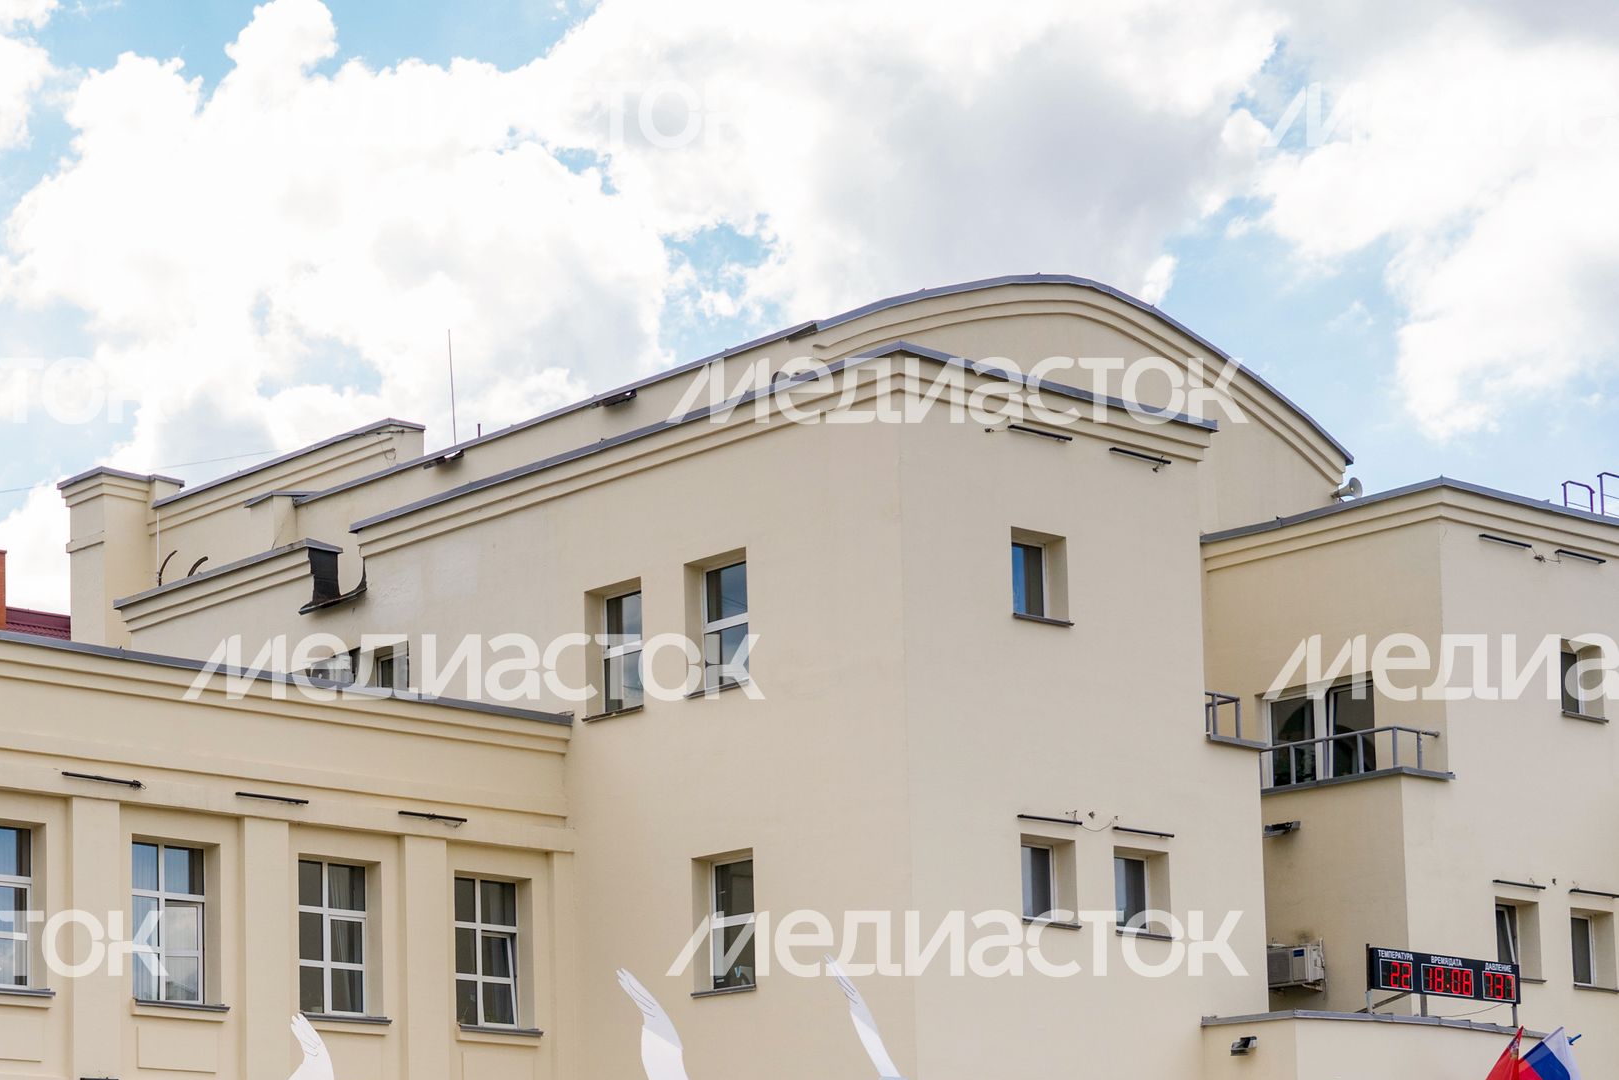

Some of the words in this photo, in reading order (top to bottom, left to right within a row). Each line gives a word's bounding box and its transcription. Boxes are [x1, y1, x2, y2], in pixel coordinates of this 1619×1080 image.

[1378, 949, 1414, 961] ТЕМПЕРАТУРА
[1485, 962, 1512, 973] ДАВЛЕНИЕ
[1390, 961, 1412, 989] 22
[1484, 972, 1515, 999] 737
